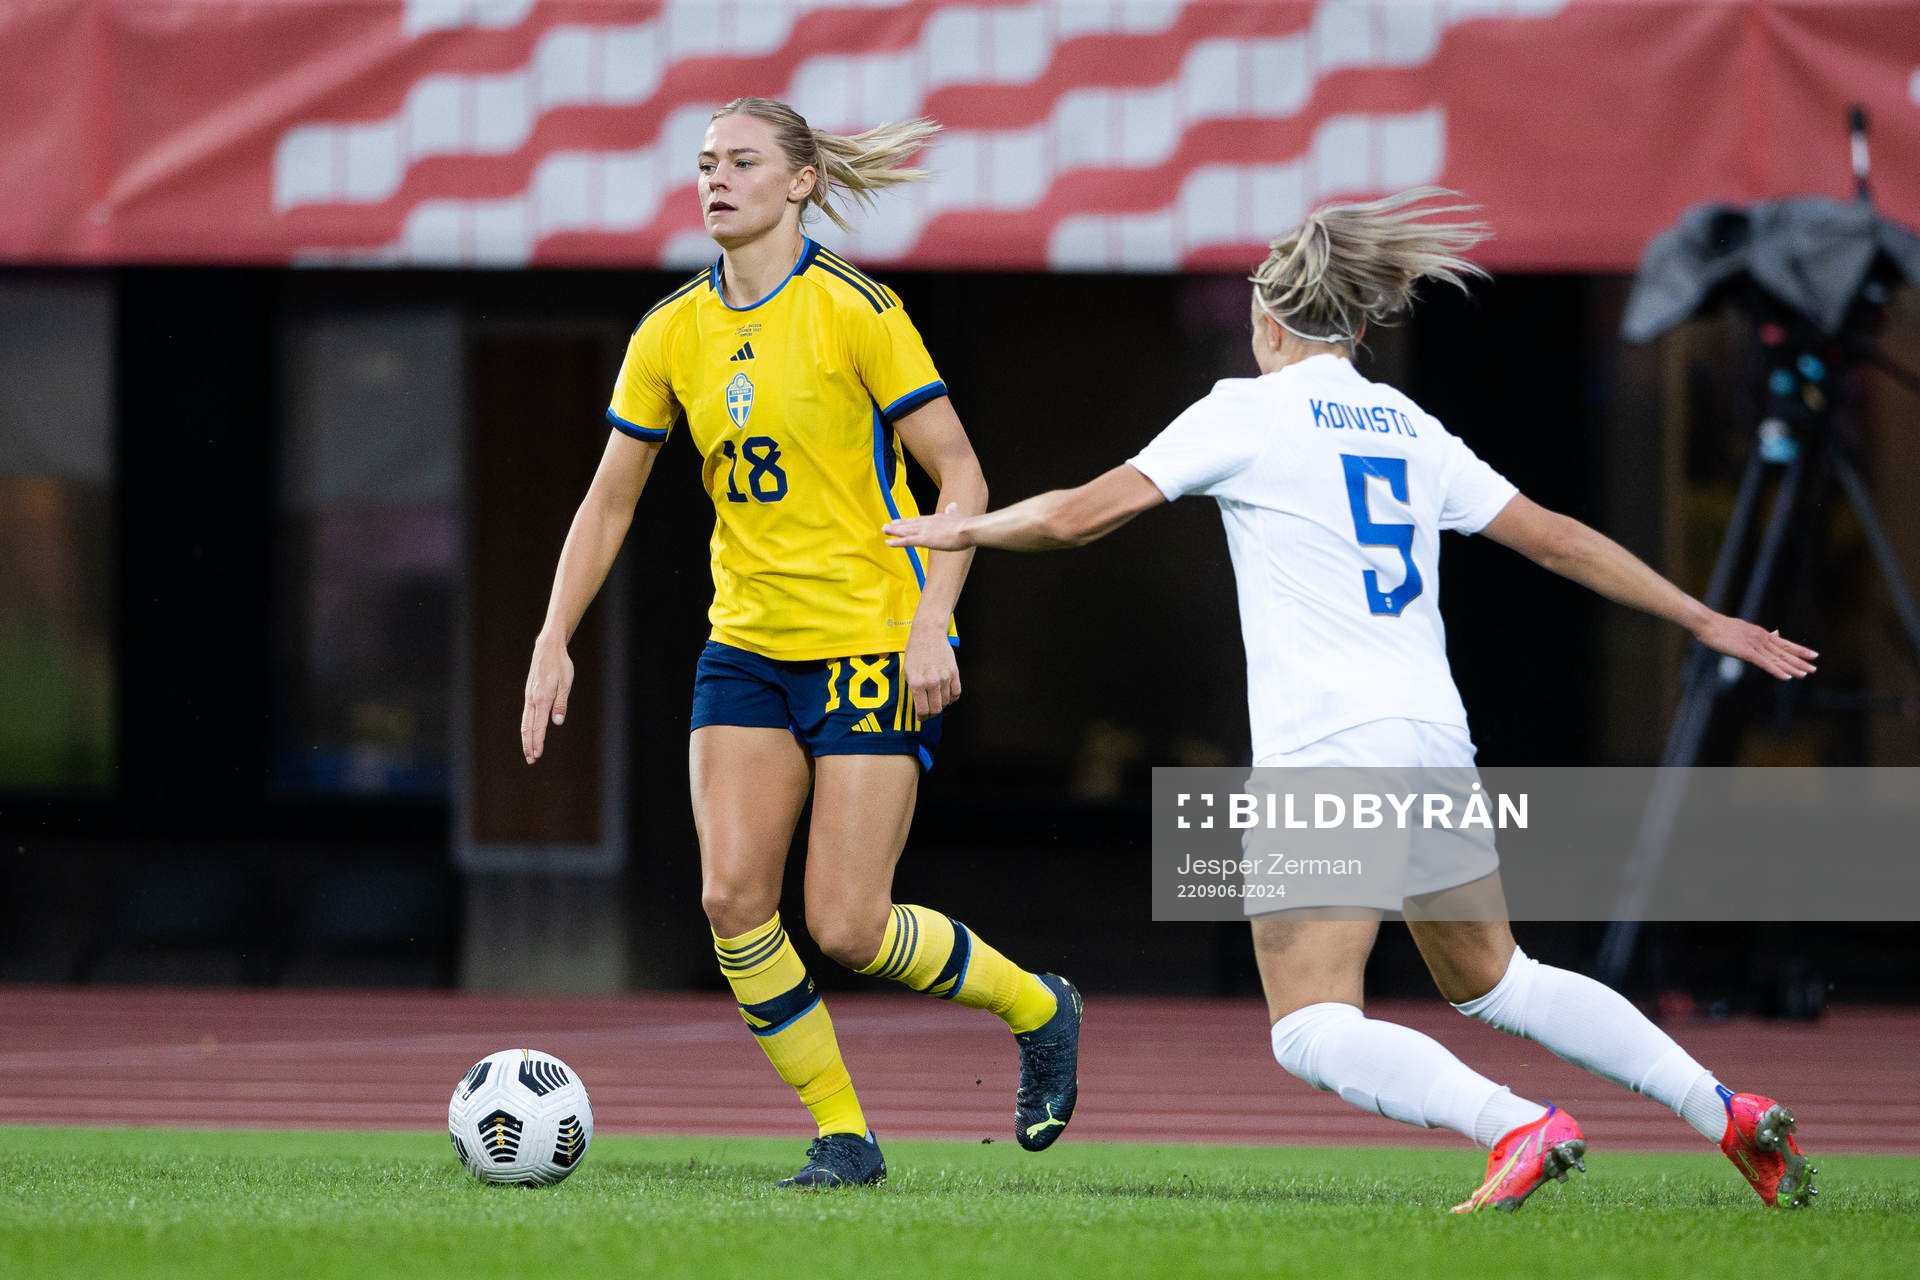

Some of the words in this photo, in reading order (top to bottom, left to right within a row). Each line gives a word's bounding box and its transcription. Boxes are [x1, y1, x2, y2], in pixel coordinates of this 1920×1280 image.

[1309, 398, 1417, 438] KOIVISTO
[722, 436, 788, 503] 18
[1339, 453, 1423, 617] 5
[825, 656, 890, 713] 18
